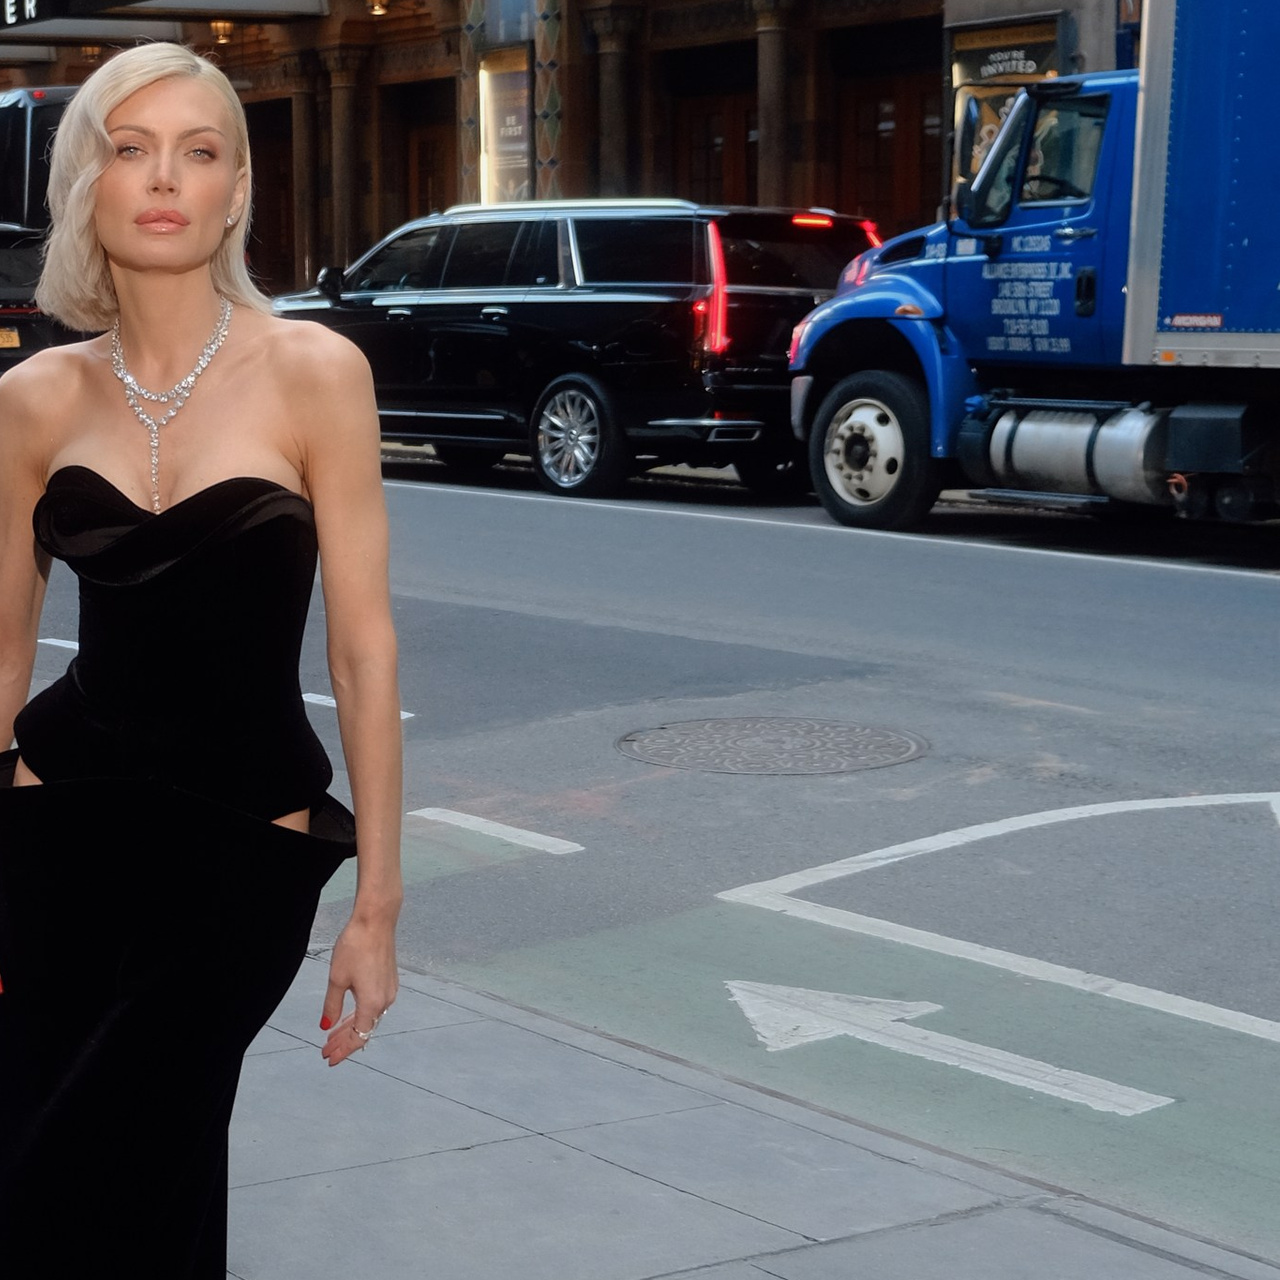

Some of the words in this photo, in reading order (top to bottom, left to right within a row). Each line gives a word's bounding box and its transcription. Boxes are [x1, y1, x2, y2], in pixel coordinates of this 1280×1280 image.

[988, 50, 1026, 62] YOU'RE
[980, 60, 1037, 78] INVITED
[500, 126, 522, 136] FIRST
[1173, 315, 1221, 327] MORGAN
